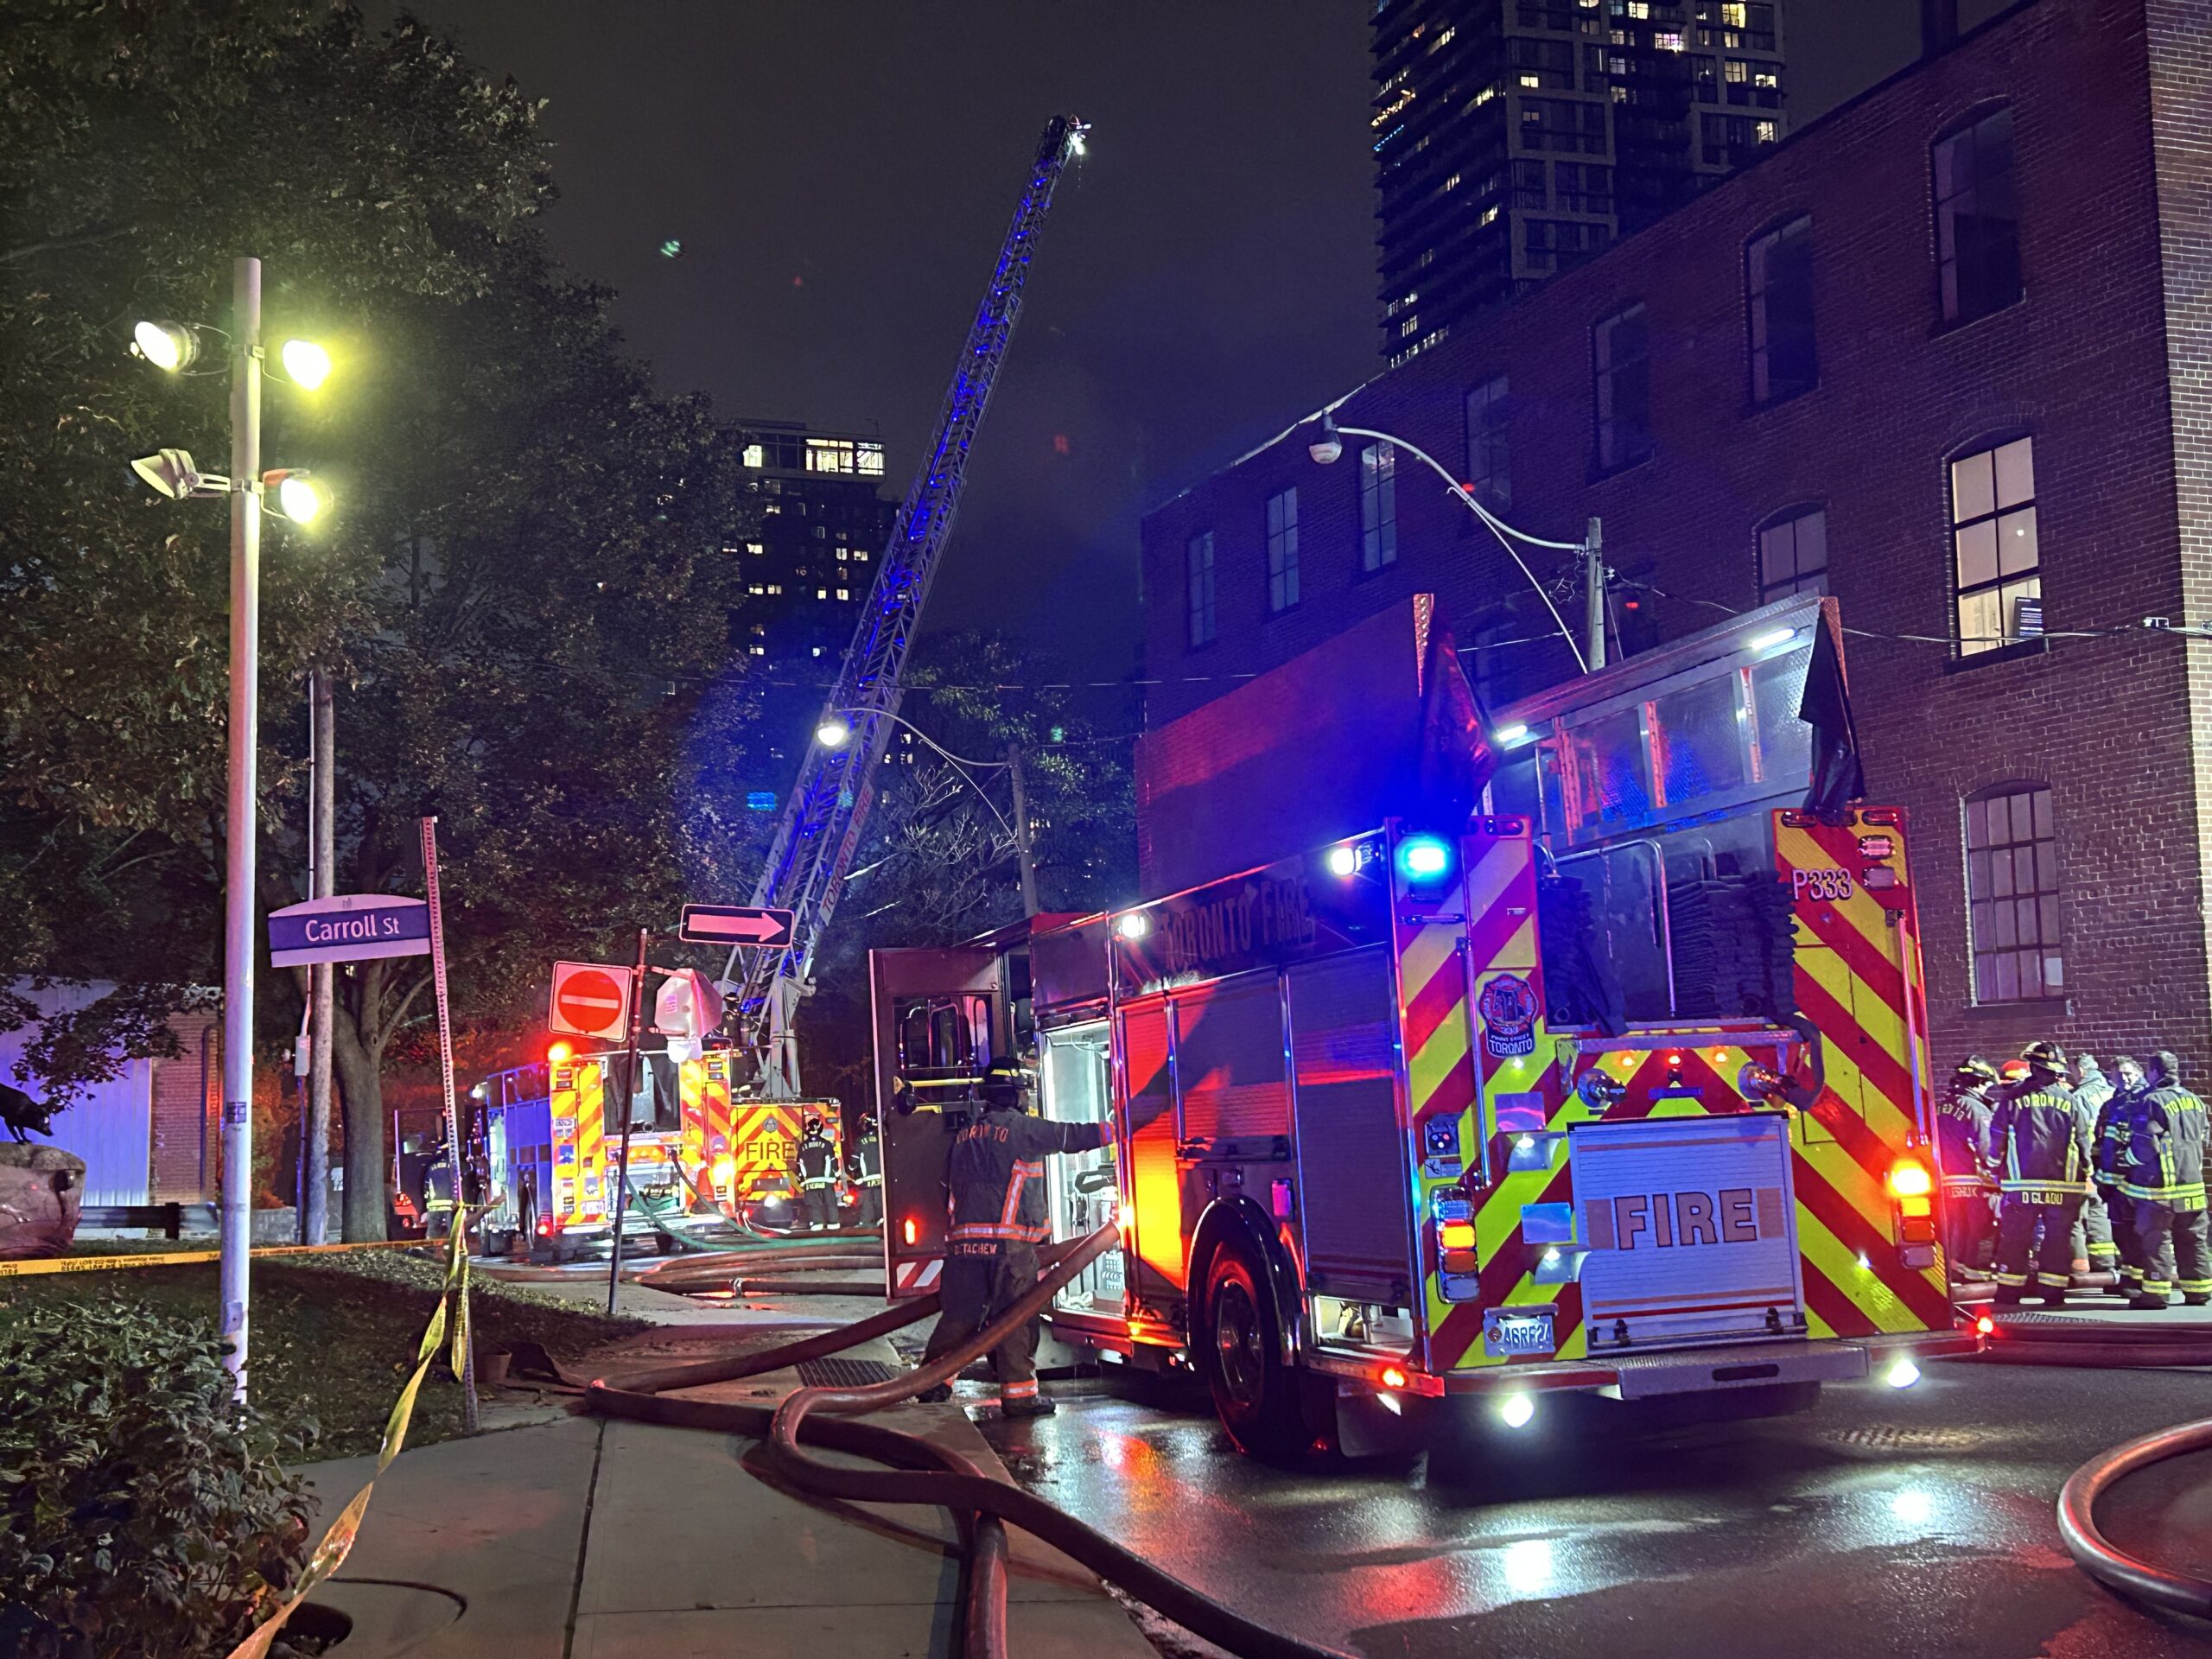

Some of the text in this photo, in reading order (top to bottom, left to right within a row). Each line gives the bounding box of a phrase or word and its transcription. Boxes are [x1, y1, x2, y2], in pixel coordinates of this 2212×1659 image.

[823, 830, 856, 913] TORONTO
[1792, 868, 1853, 899] P333
[305, 914, 400, 942] Carroll St
[1160, 879, 1315, 972] TORONTO FIRE
[1489, 1038, 1533, 1055] TORONTO
[2015, 1093, 2072, 1113] TORONTO
[746, 1141, 797, 1160] FIRE
[1614, 1188, 1758, 1250] FIRE
